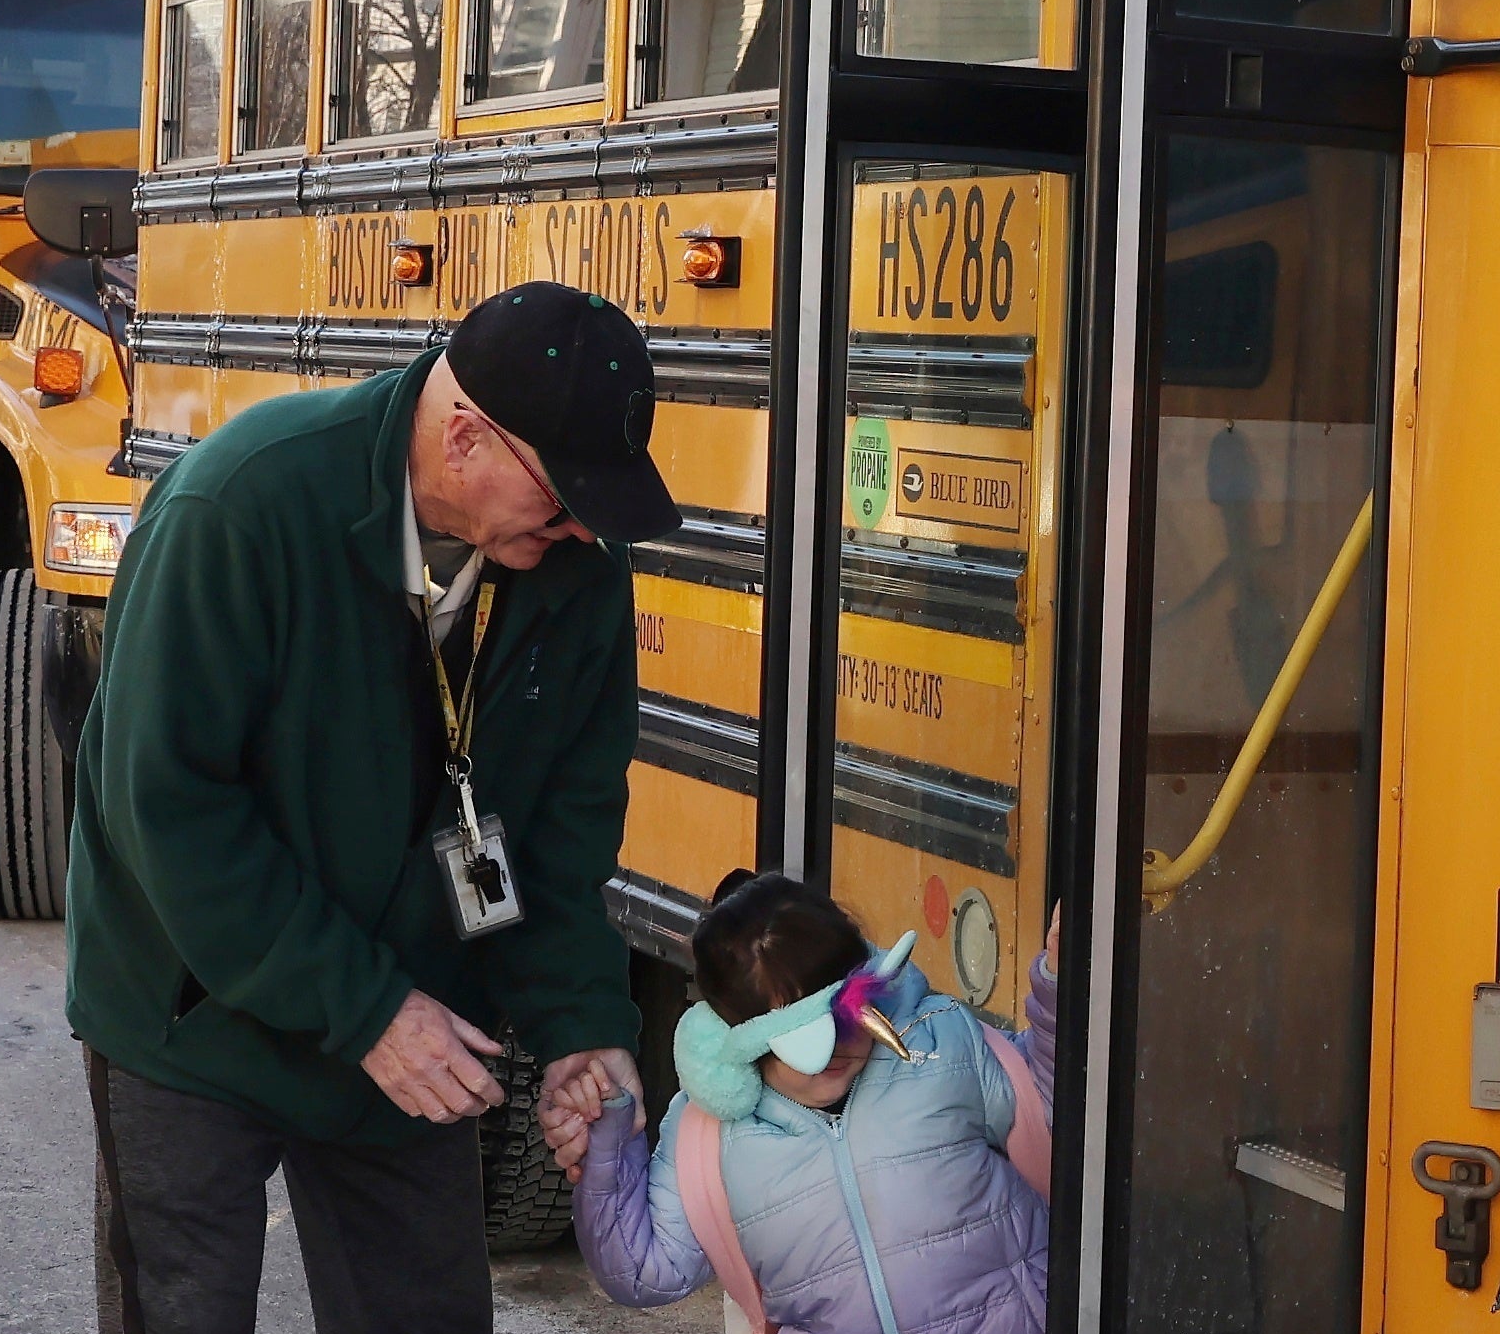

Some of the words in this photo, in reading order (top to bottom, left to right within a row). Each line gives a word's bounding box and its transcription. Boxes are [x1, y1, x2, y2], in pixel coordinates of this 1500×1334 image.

[545, 201, 670, 316] SCHOOLS
[877, 185, 1016, 322] HS286
[851, 450, 888, 490] PROPANE
[929, 472, 968, 503] BLUE
[903, 668, 943, 721] SEATS
